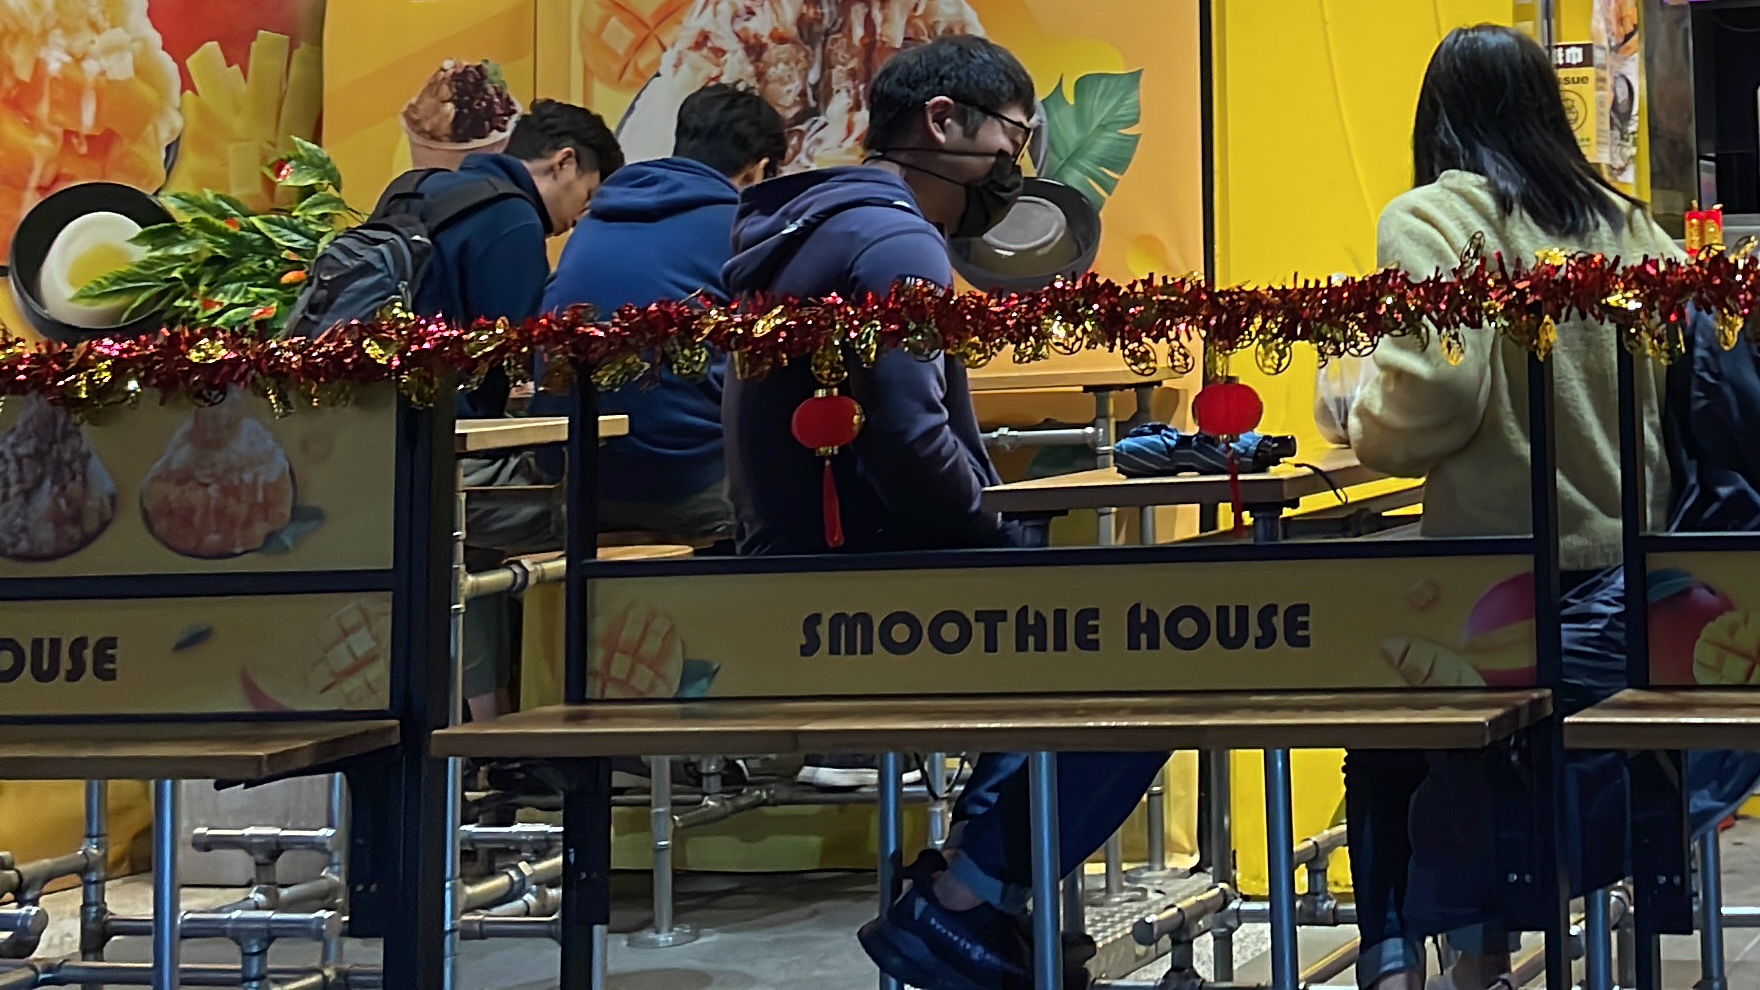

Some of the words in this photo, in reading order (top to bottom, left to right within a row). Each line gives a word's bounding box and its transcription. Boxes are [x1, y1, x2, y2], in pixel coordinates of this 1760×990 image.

[800, 604, 1100, 657] SMOOTHIE
[1126, 601, 1312, 652] HOUSE
[0, 636, 118, 684] OUSE
